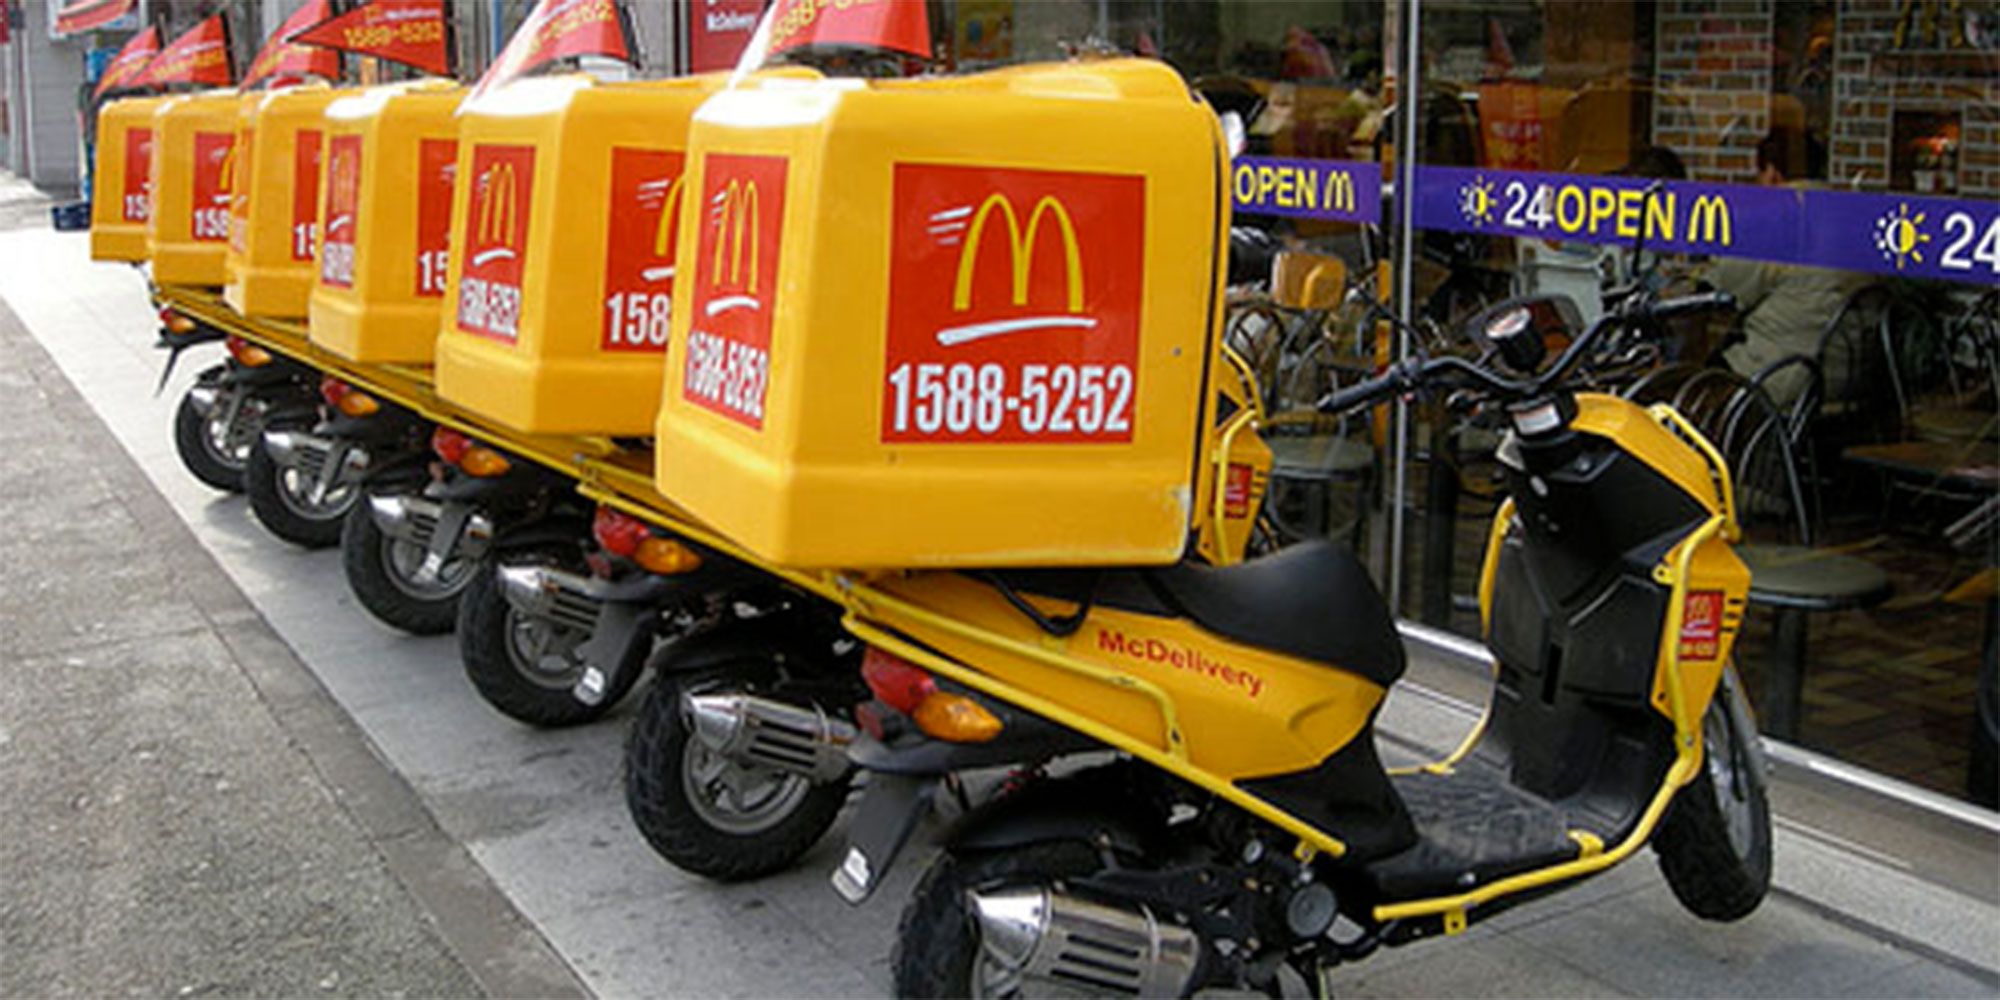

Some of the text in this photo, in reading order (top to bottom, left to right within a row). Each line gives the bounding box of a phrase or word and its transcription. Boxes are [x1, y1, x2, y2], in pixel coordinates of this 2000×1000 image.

[1235, 163, 1318, 210] OPEN
[1941, 210, 2000, 273] 24
[606, 292, 670, 346] 158
[889, 363, 1133, 433] 1588-5252
[1097, 628, 1266, 698] McDelivery
